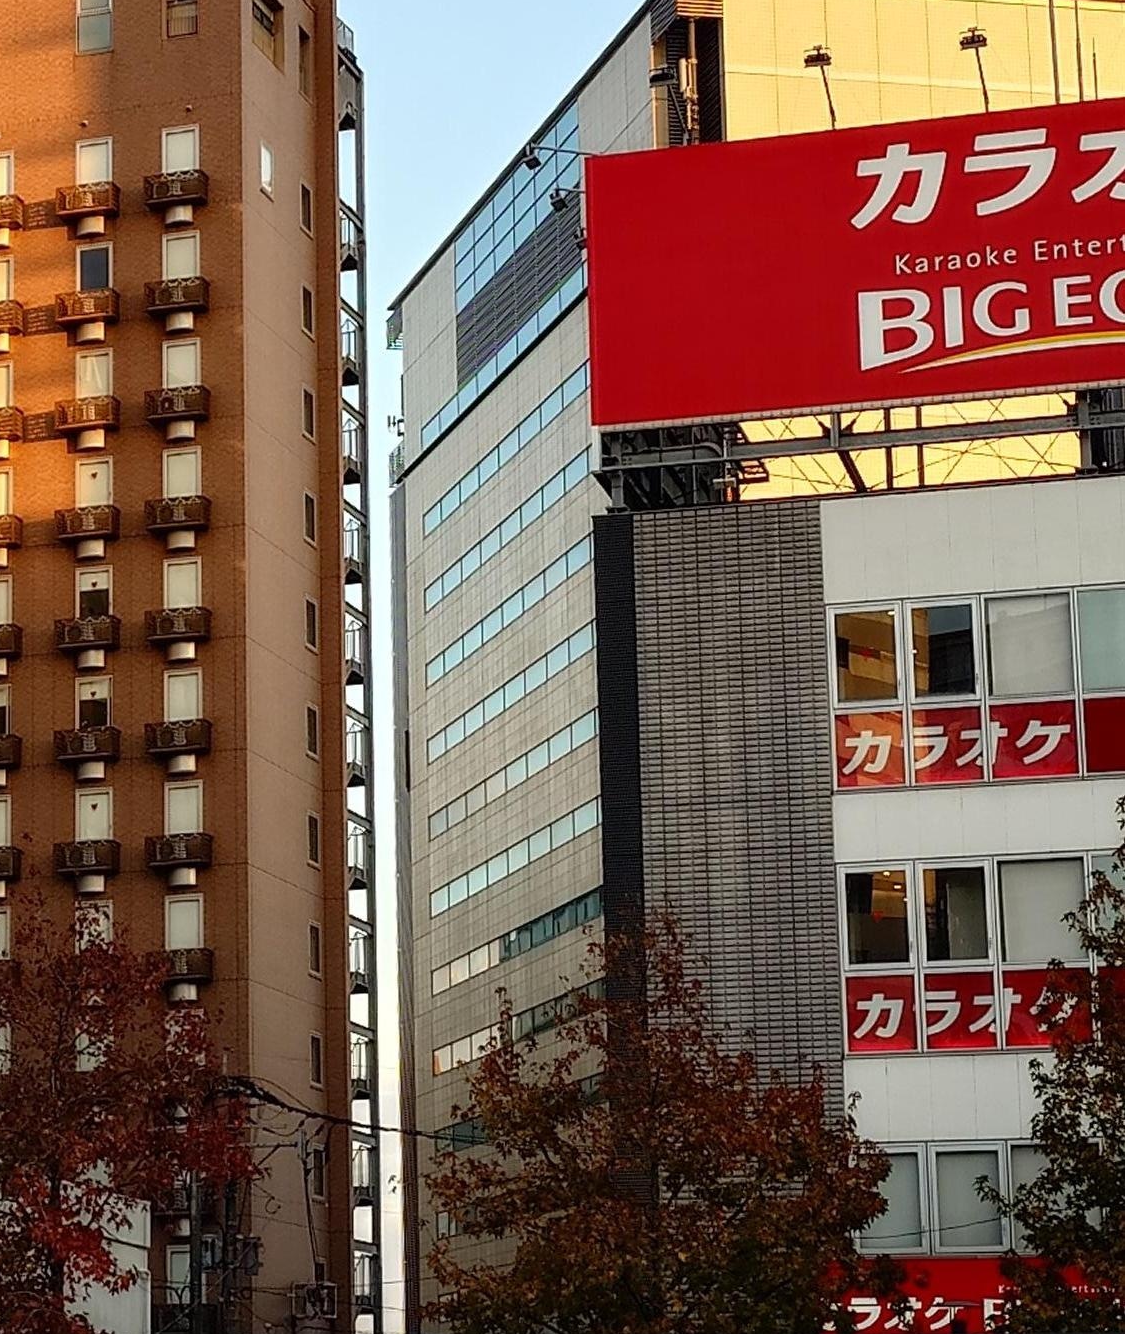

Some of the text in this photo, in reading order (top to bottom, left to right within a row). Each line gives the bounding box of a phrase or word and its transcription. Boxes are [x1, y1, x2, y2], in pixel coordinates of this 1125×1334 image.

[895, 245, 1017, 275] Karaoke
[857, 281, 1030, 371] BIG
[842, 720, 1071, 776] カラオケ
